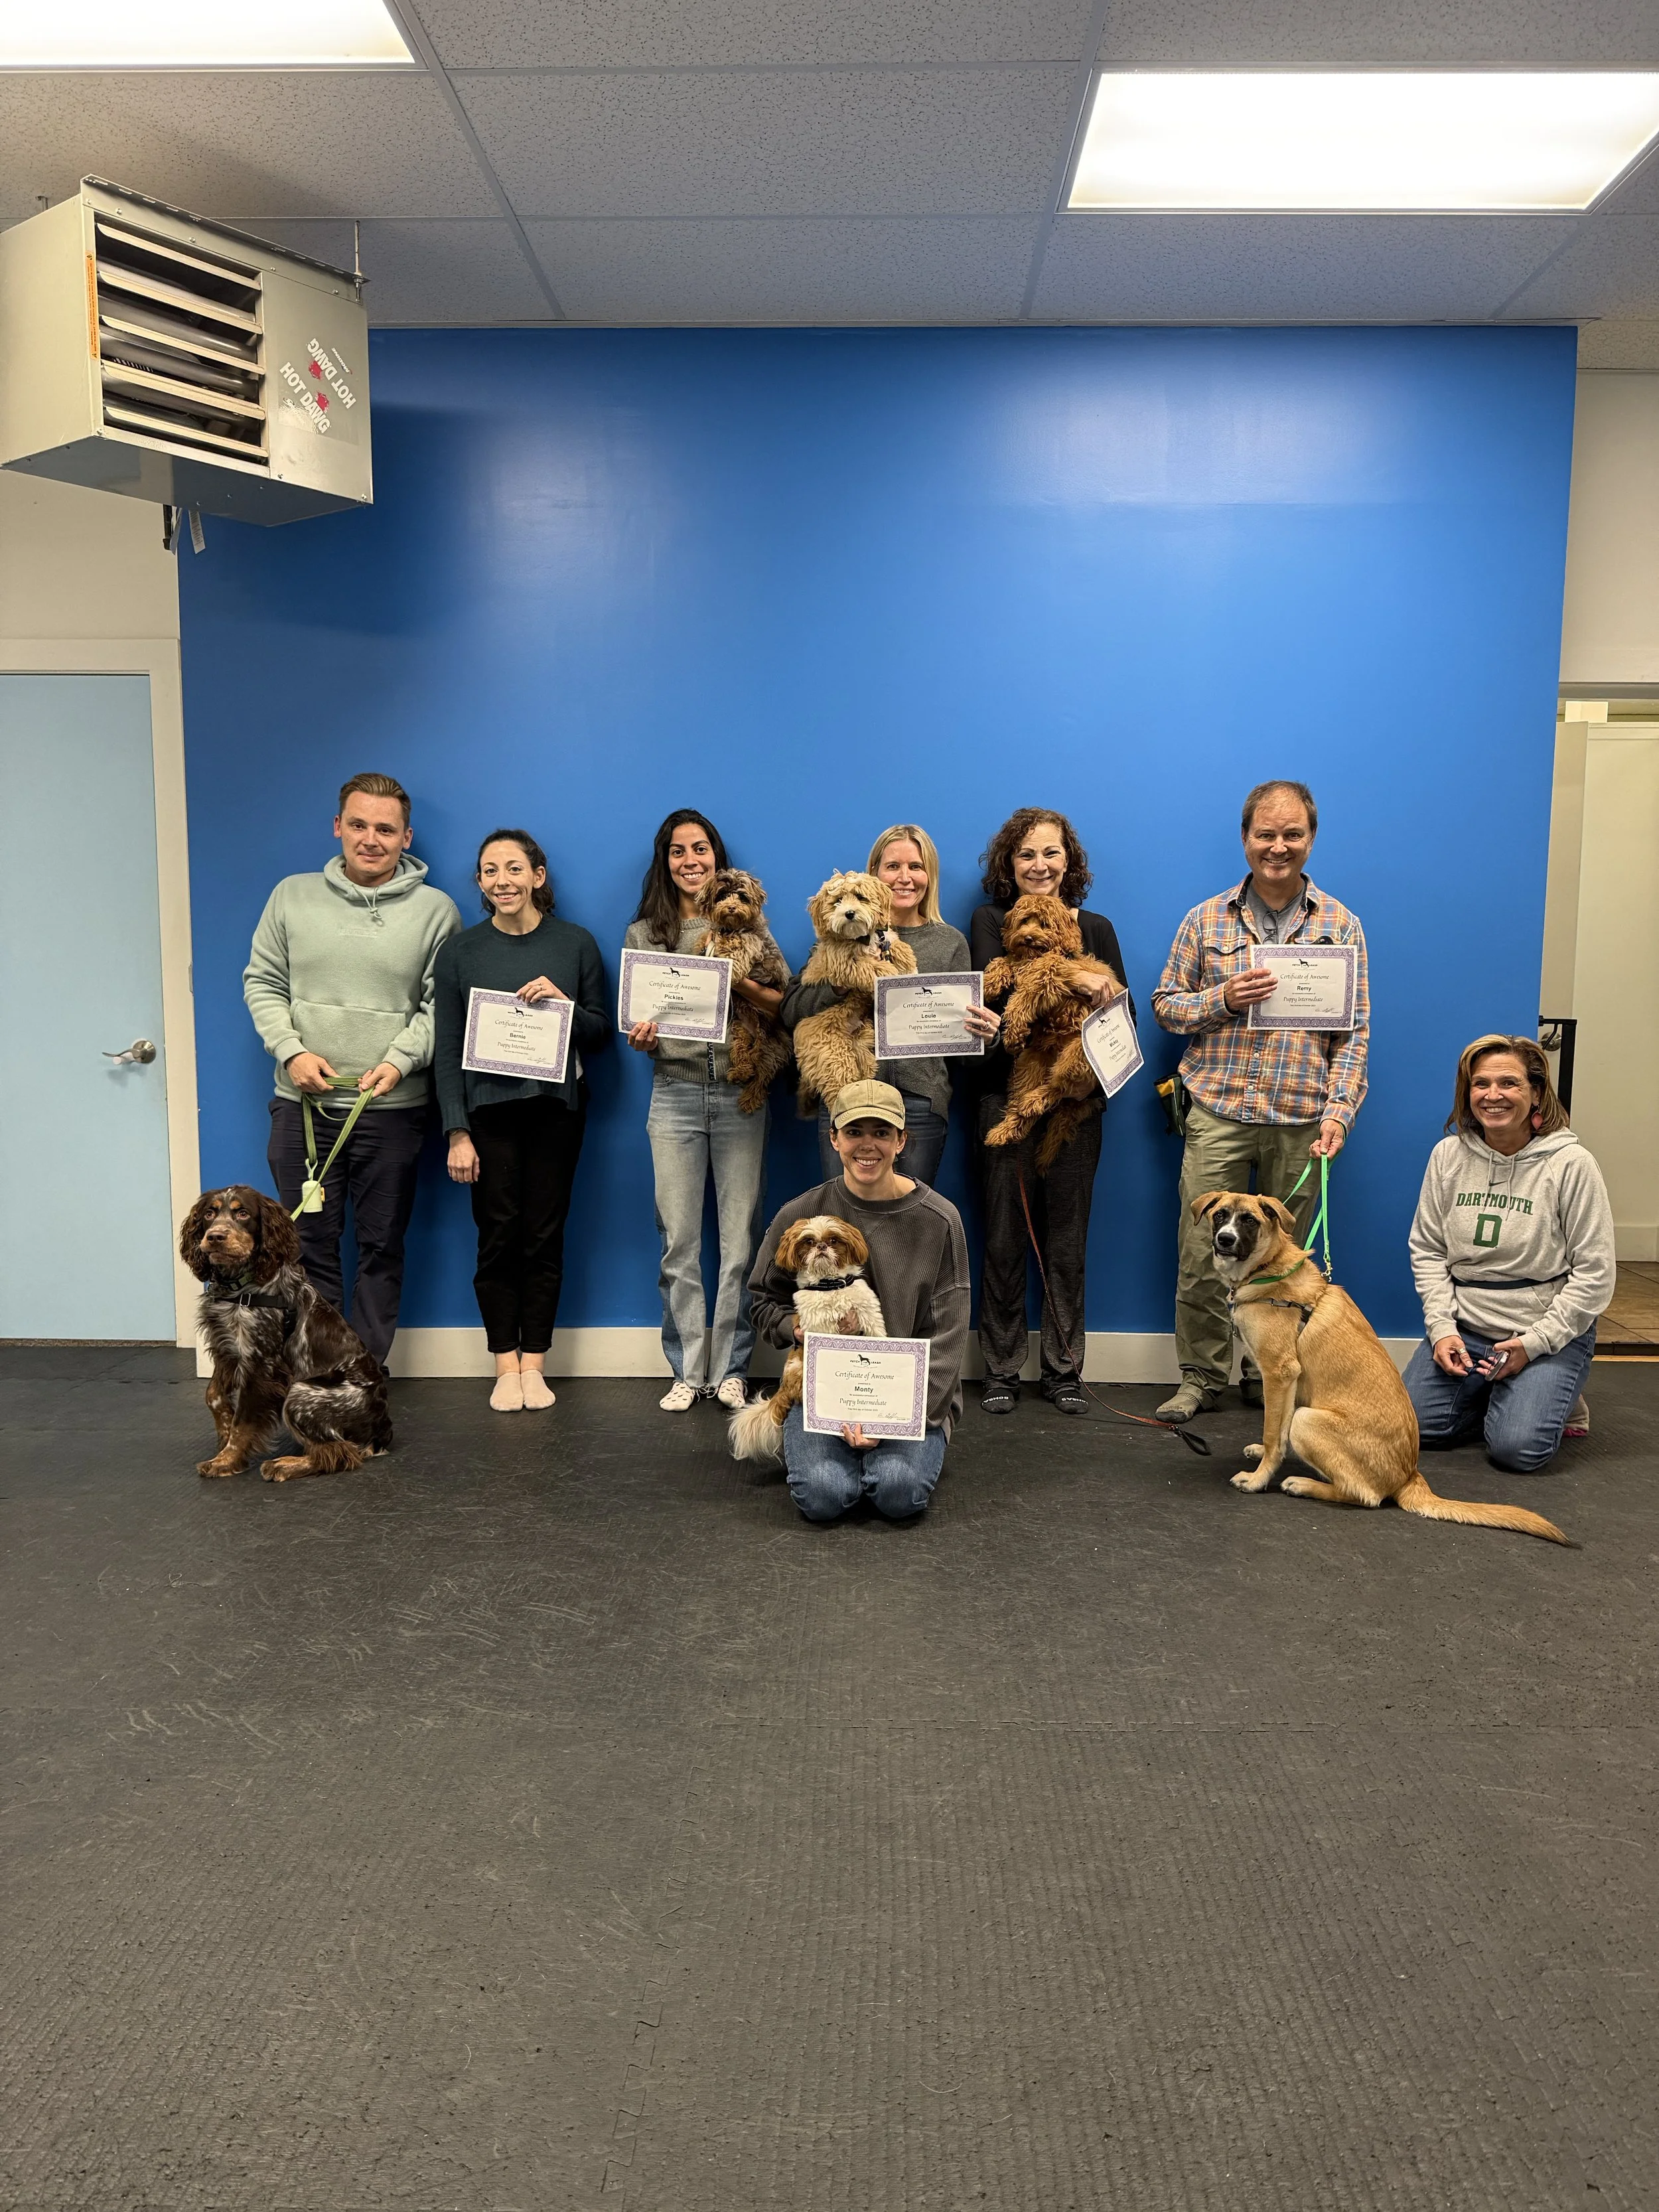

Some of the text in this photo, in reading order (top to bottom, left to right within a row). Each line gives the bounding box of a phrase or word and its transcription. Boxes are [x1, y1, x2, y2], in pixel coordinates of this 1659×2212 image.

[332, 347, 350, 374] MODINE
[307, 338, 356, 409] HOT DAWG
[279, 362, 307, 394] HOT
[299, 391, 330, 433] DAWG
[1280, 974, 1304, 983] Certificate
[1304, 973, 1310, 982] of
[649, 980, 674, 990] Certificate
[674, 982, 680, 991] of
[652, 1003, 667, 1012] Puppy
[928, 1000, 934, 1009] of
[495, 1019, 518, 1028] Certificate
[497, 1041, 536, 1052] Puppy Intermediate
[1456, 1193, 1534, 1215] DARTMOUTH
[1473, 1213, 1503, 1248] D
[835, 1370, 863, 1380] Certificate
[864, 1371, 871, 1381] of
[839, 1398, 856, 1407] Puppy
